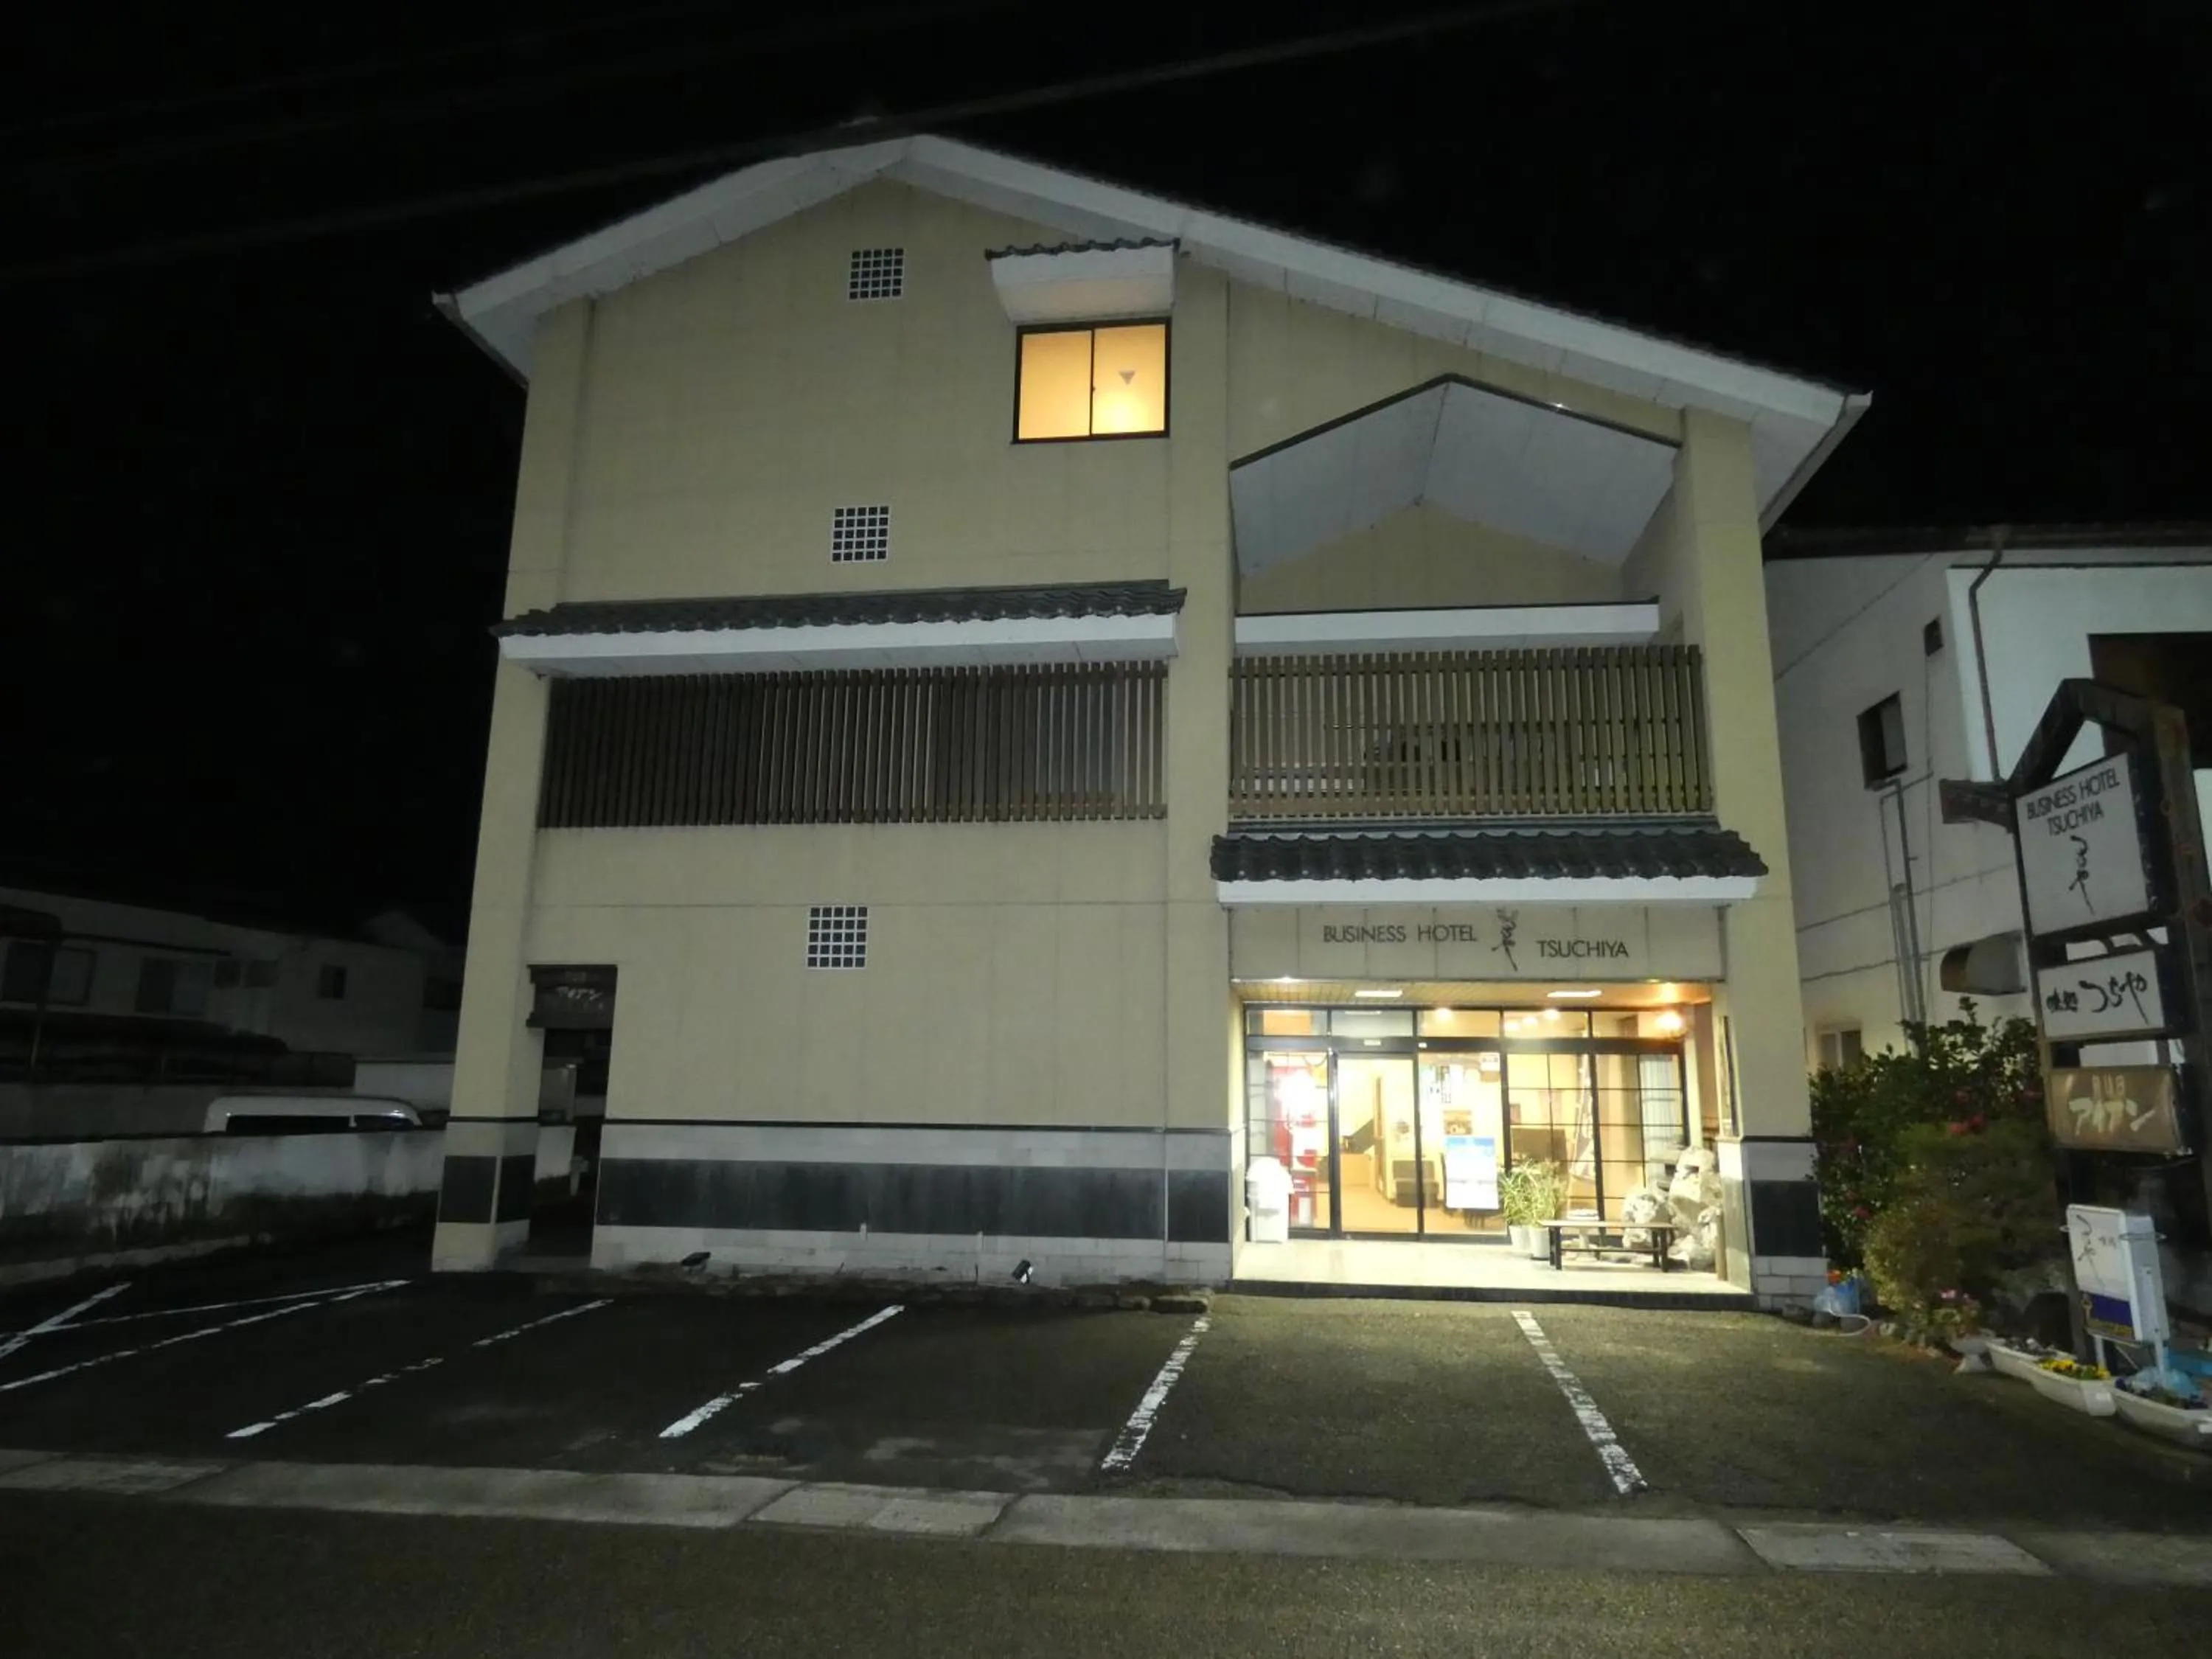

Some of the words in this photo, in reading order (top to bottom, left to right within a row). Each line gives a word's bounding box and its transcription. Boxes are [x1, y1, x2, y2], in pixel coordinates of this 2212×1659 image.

[2027, 785, 2077, 821] BUSINESS
[2079, 768, 2120, 799] HOTEL
[2048, 800, 2104, 836] TSUCHIYA
[1324, 925, 1406, 943] BUSINESS
[1417, 925, 1478, 942] HOTEL
[1537, 939, 1629, 958] TSUCHIYA
